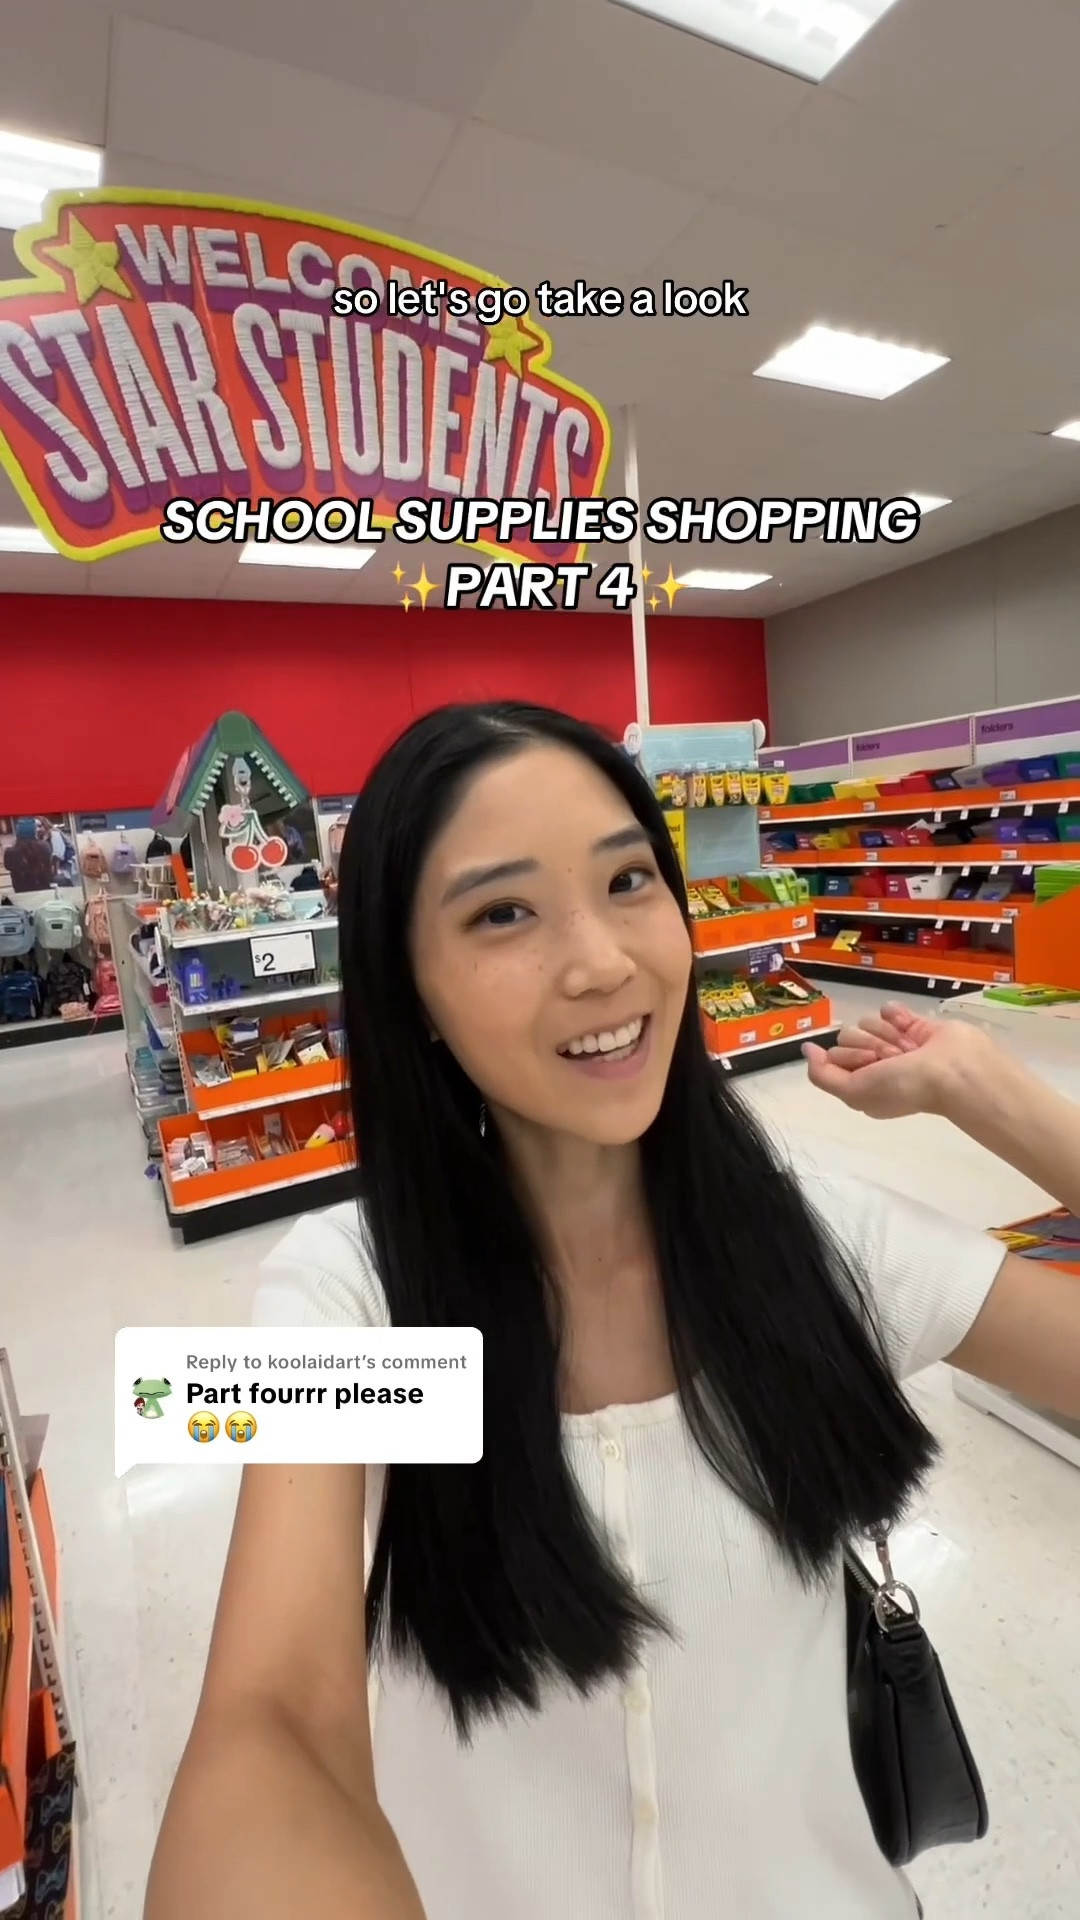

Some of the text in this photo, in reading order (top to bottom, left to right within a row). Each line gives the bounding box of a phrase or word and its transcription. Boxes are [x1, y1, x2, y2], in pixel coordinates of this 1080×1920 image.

[0, 302, 590, 530] STAR STUDENTS
[981, 721, 1014, 734] folders
[254, 952, 276, 972] $2
